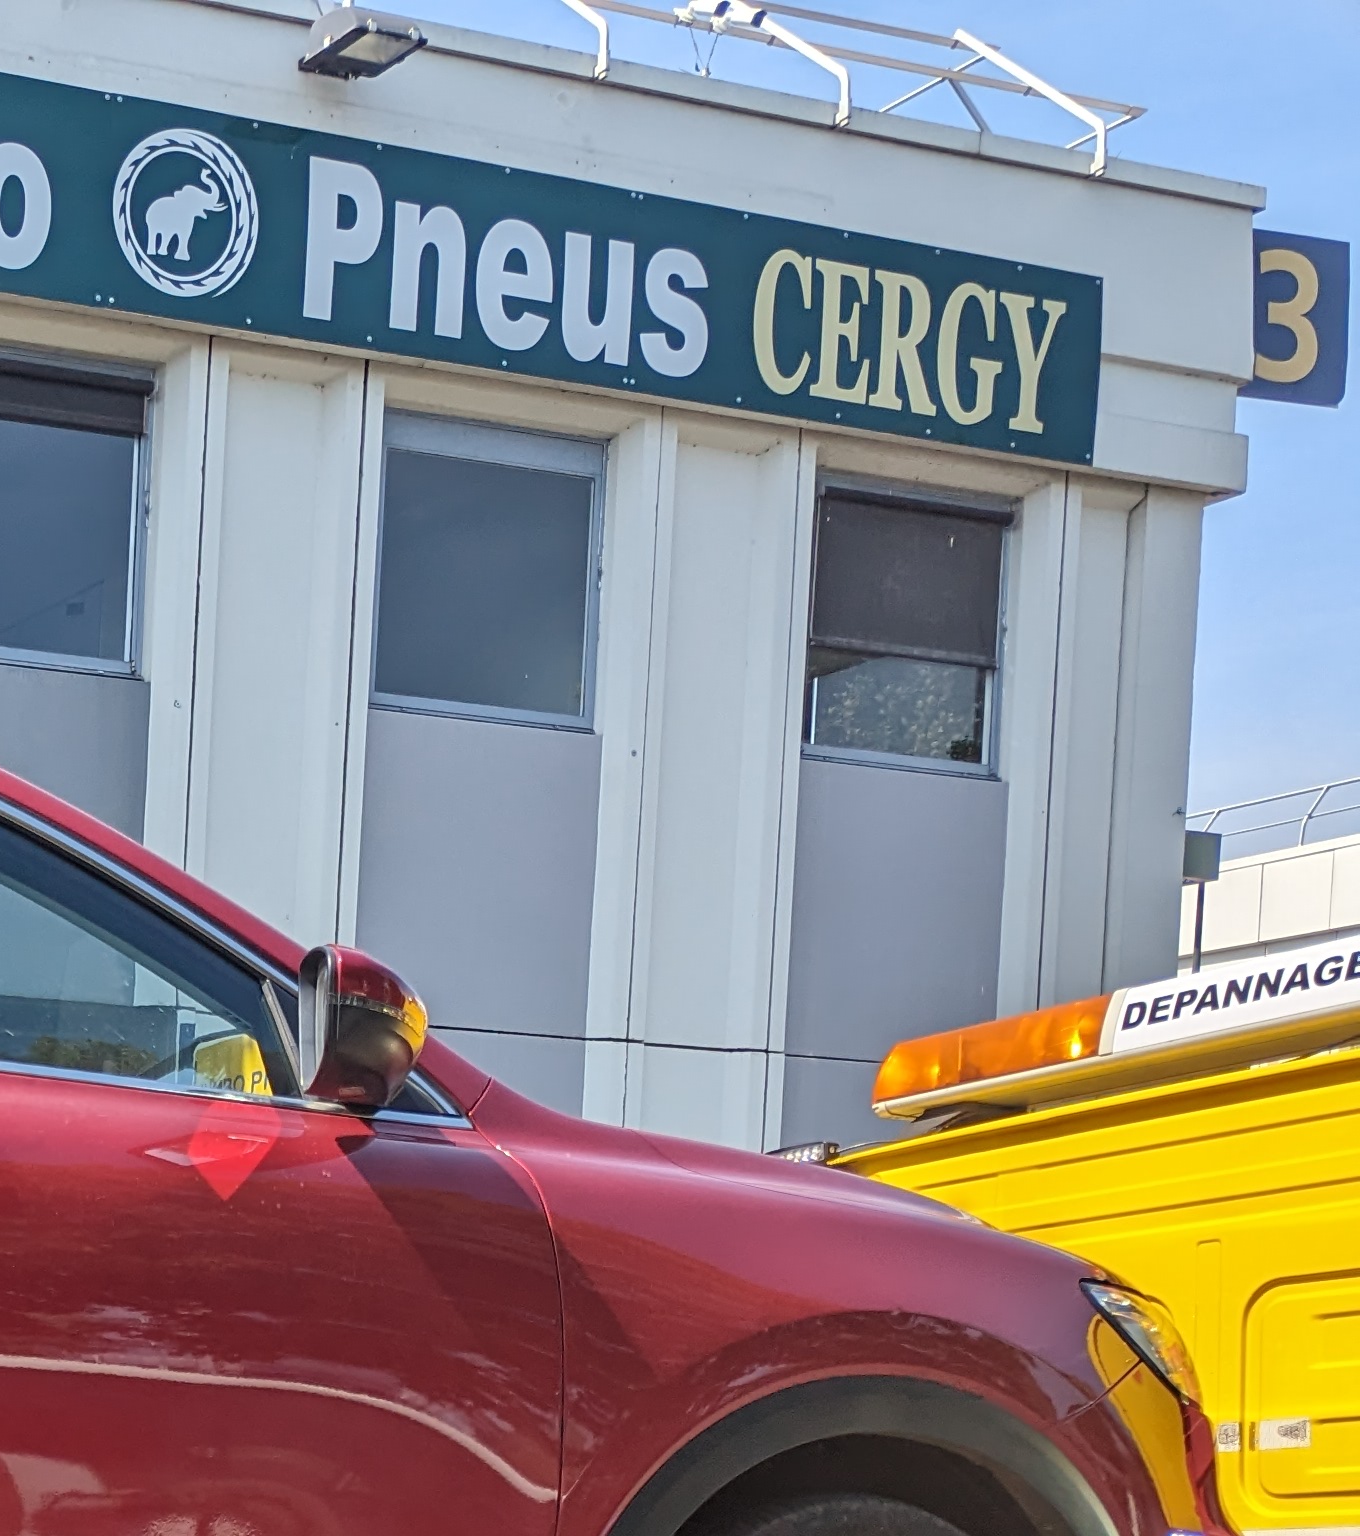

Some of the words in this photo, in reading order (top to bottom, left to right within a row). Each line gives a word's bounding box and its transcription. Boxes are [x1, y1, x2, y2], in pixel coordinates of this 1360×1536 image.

[302, 155, 709, 378] Pneus
[753, 248, 1067, 435] CERGY
[1255, 248, 1319, 383] 3
[1121, 951, 1360, 1031] DEPANNAGE
